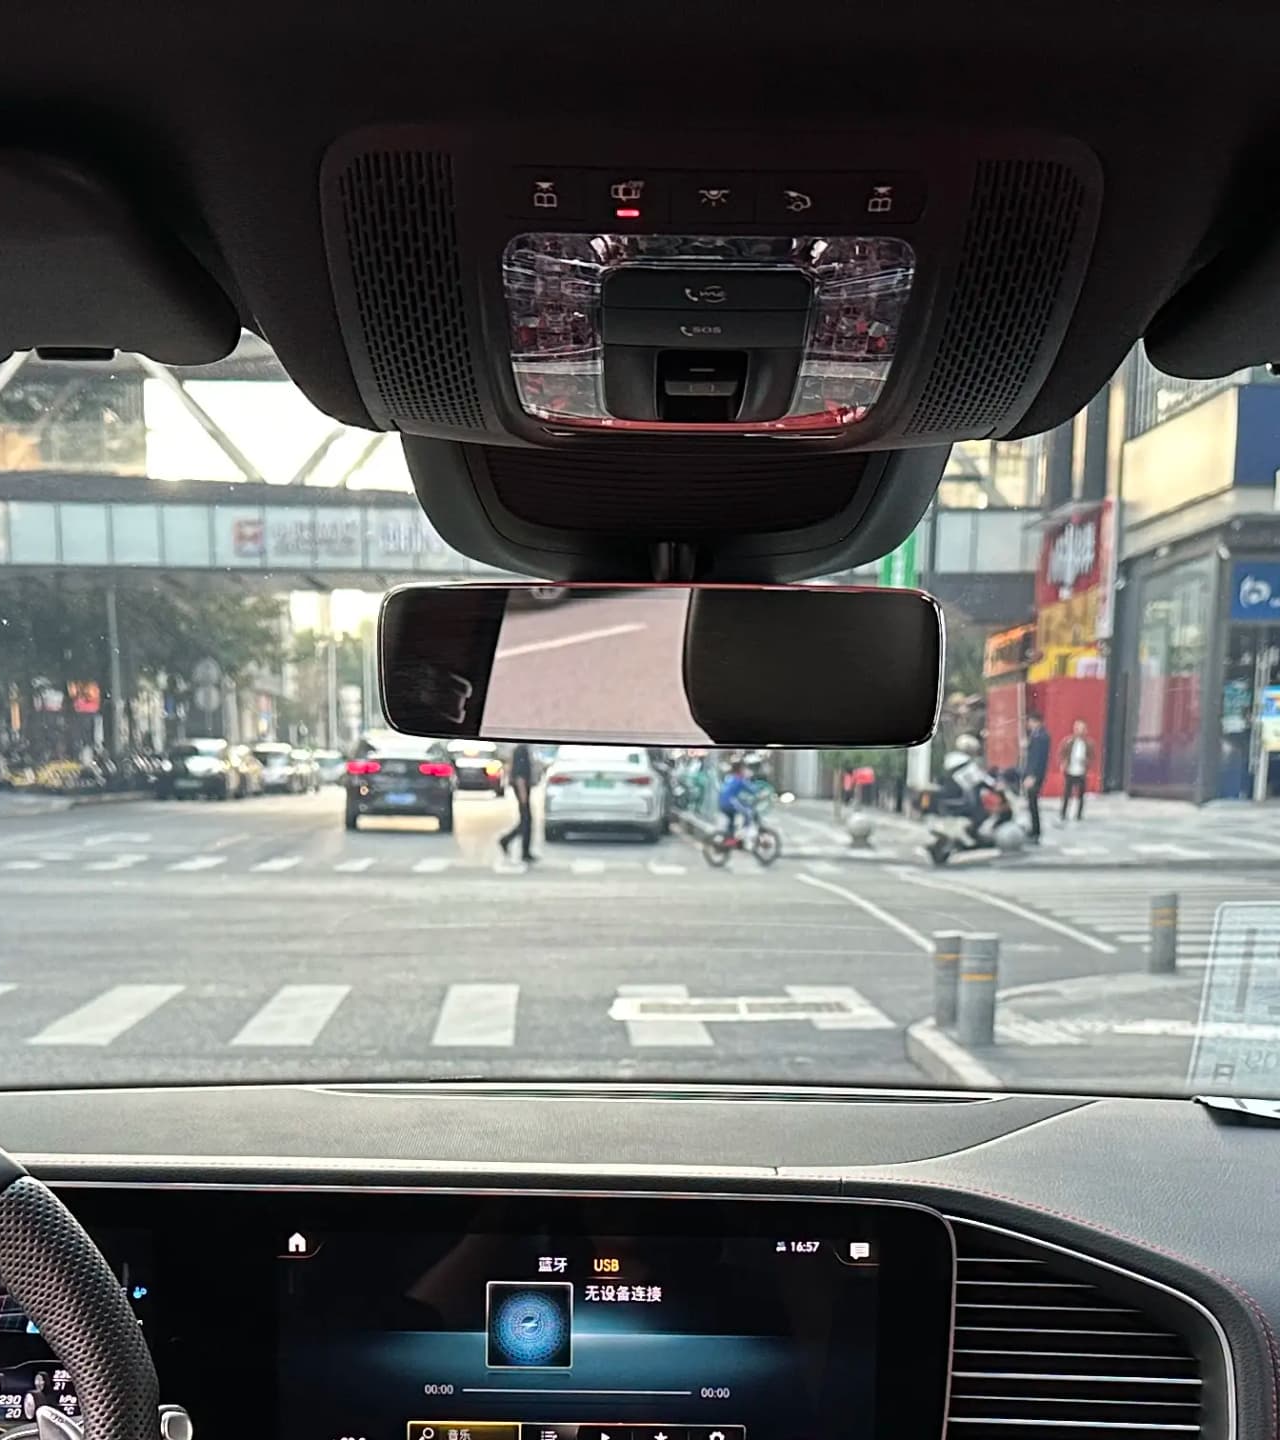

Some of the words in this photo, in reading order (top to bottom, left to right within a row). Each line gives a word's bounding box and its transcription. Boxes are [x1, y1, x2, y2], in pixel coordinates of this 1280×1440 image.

[692, 326, 722, 335] SOS
[790, 1241, 820, 1253] 16:57
[538, 1257, 568, 1273] 蓝牙
[593, 1258, 620, 1273] USB
[584, 1284, 663, 1303] 无设备连接
[424, 1383, 455, 1396] 00:00
[700, 1387, 731, 1399] 00:00
[4, 1408, 22, 1419] 20
